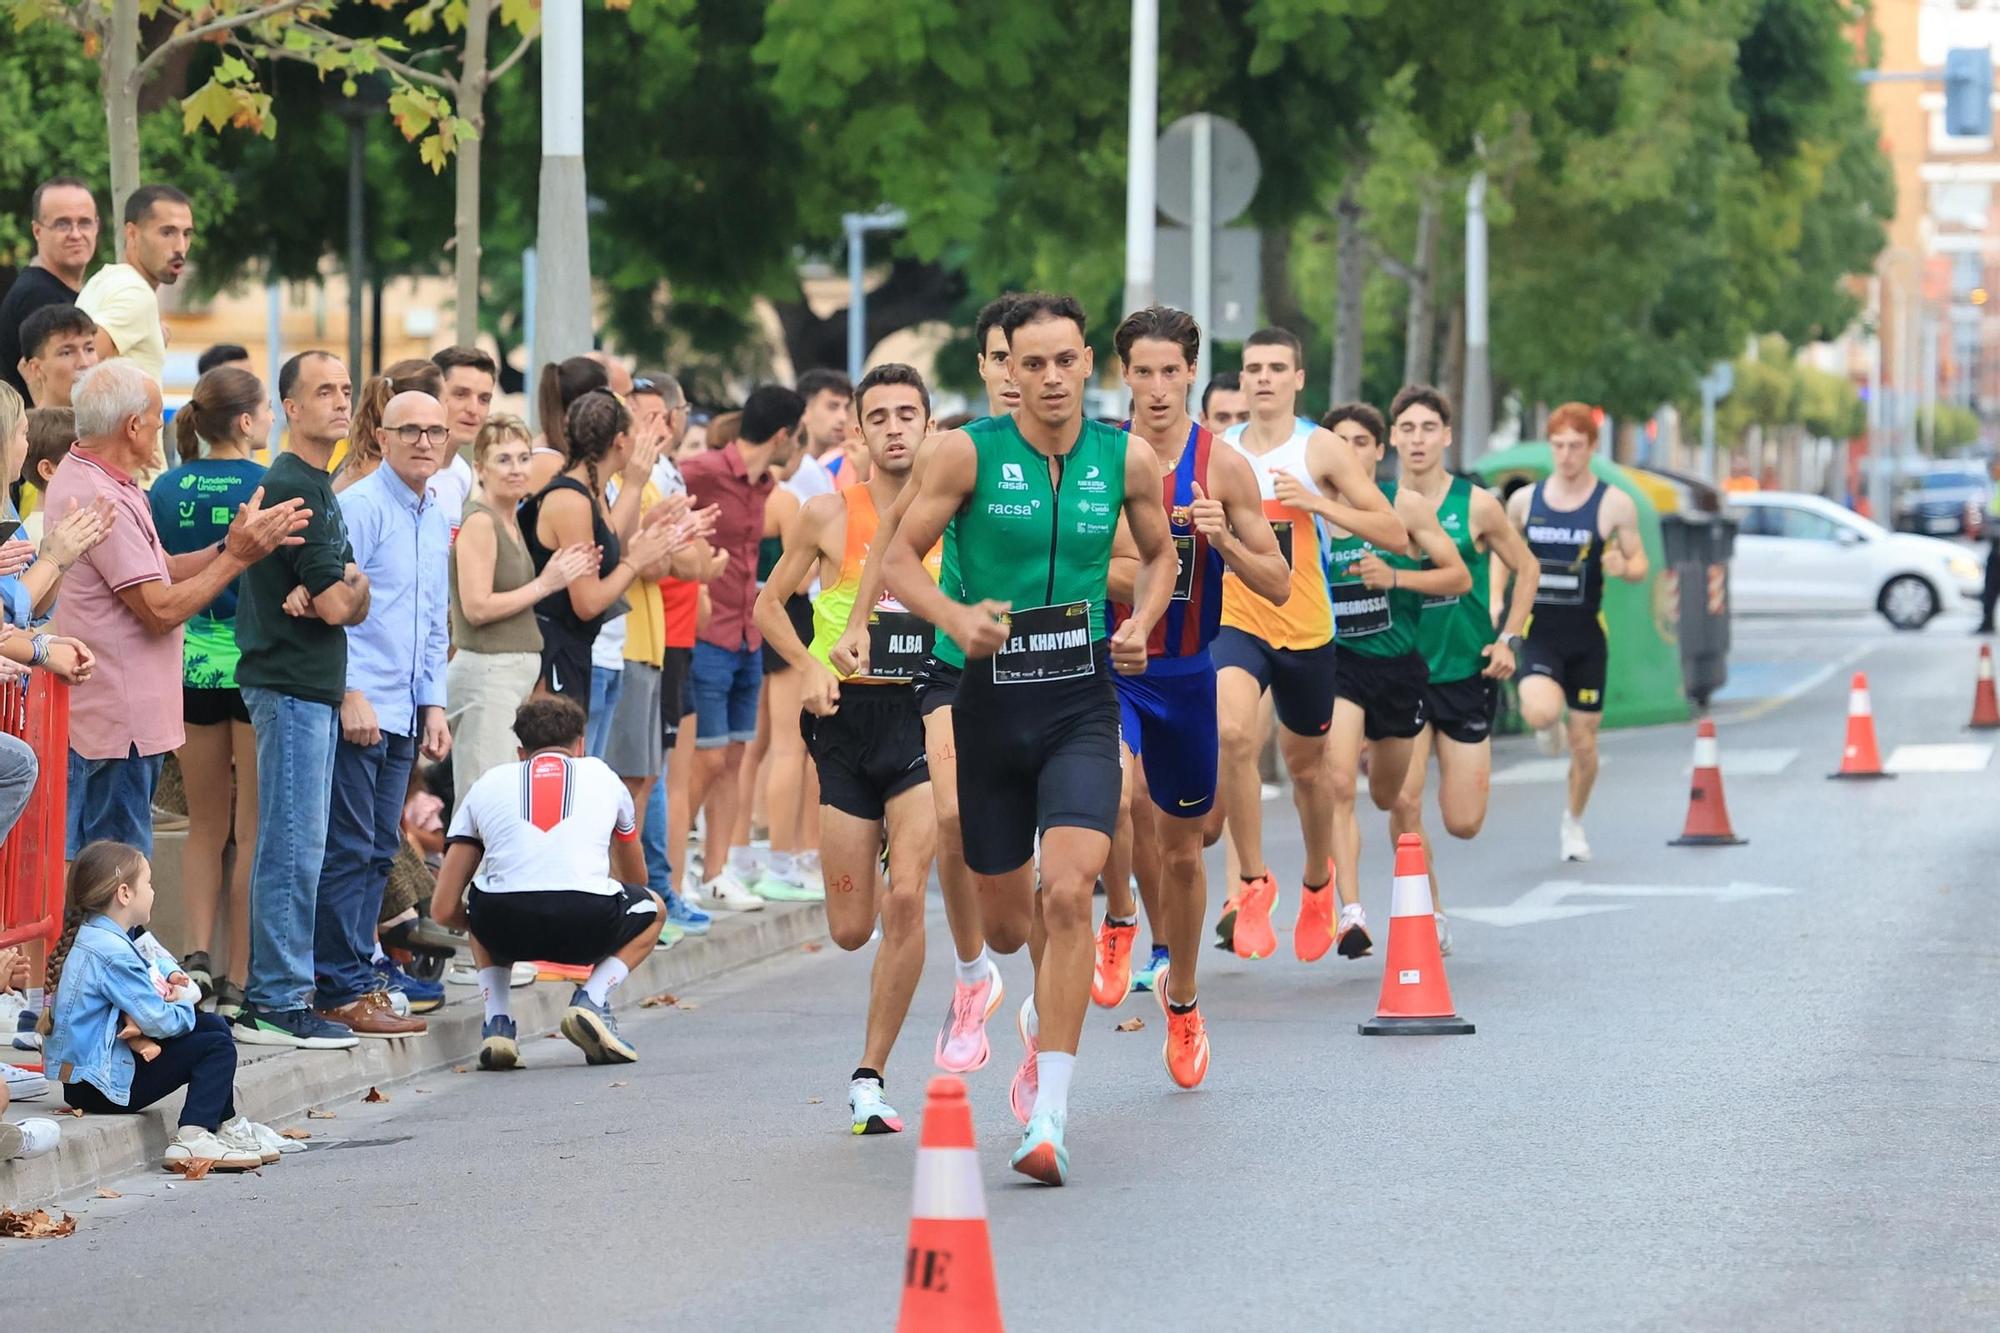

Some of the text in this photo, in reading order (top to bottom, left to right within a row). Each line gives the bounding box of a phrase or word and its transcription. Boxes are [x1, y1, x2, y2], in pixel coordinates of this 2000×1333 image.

[197, 484, 228, 493] Unicaja
[888, 634, 923, 654] ALBA
[1028, 627, 1088, 652] KHAYAMI
